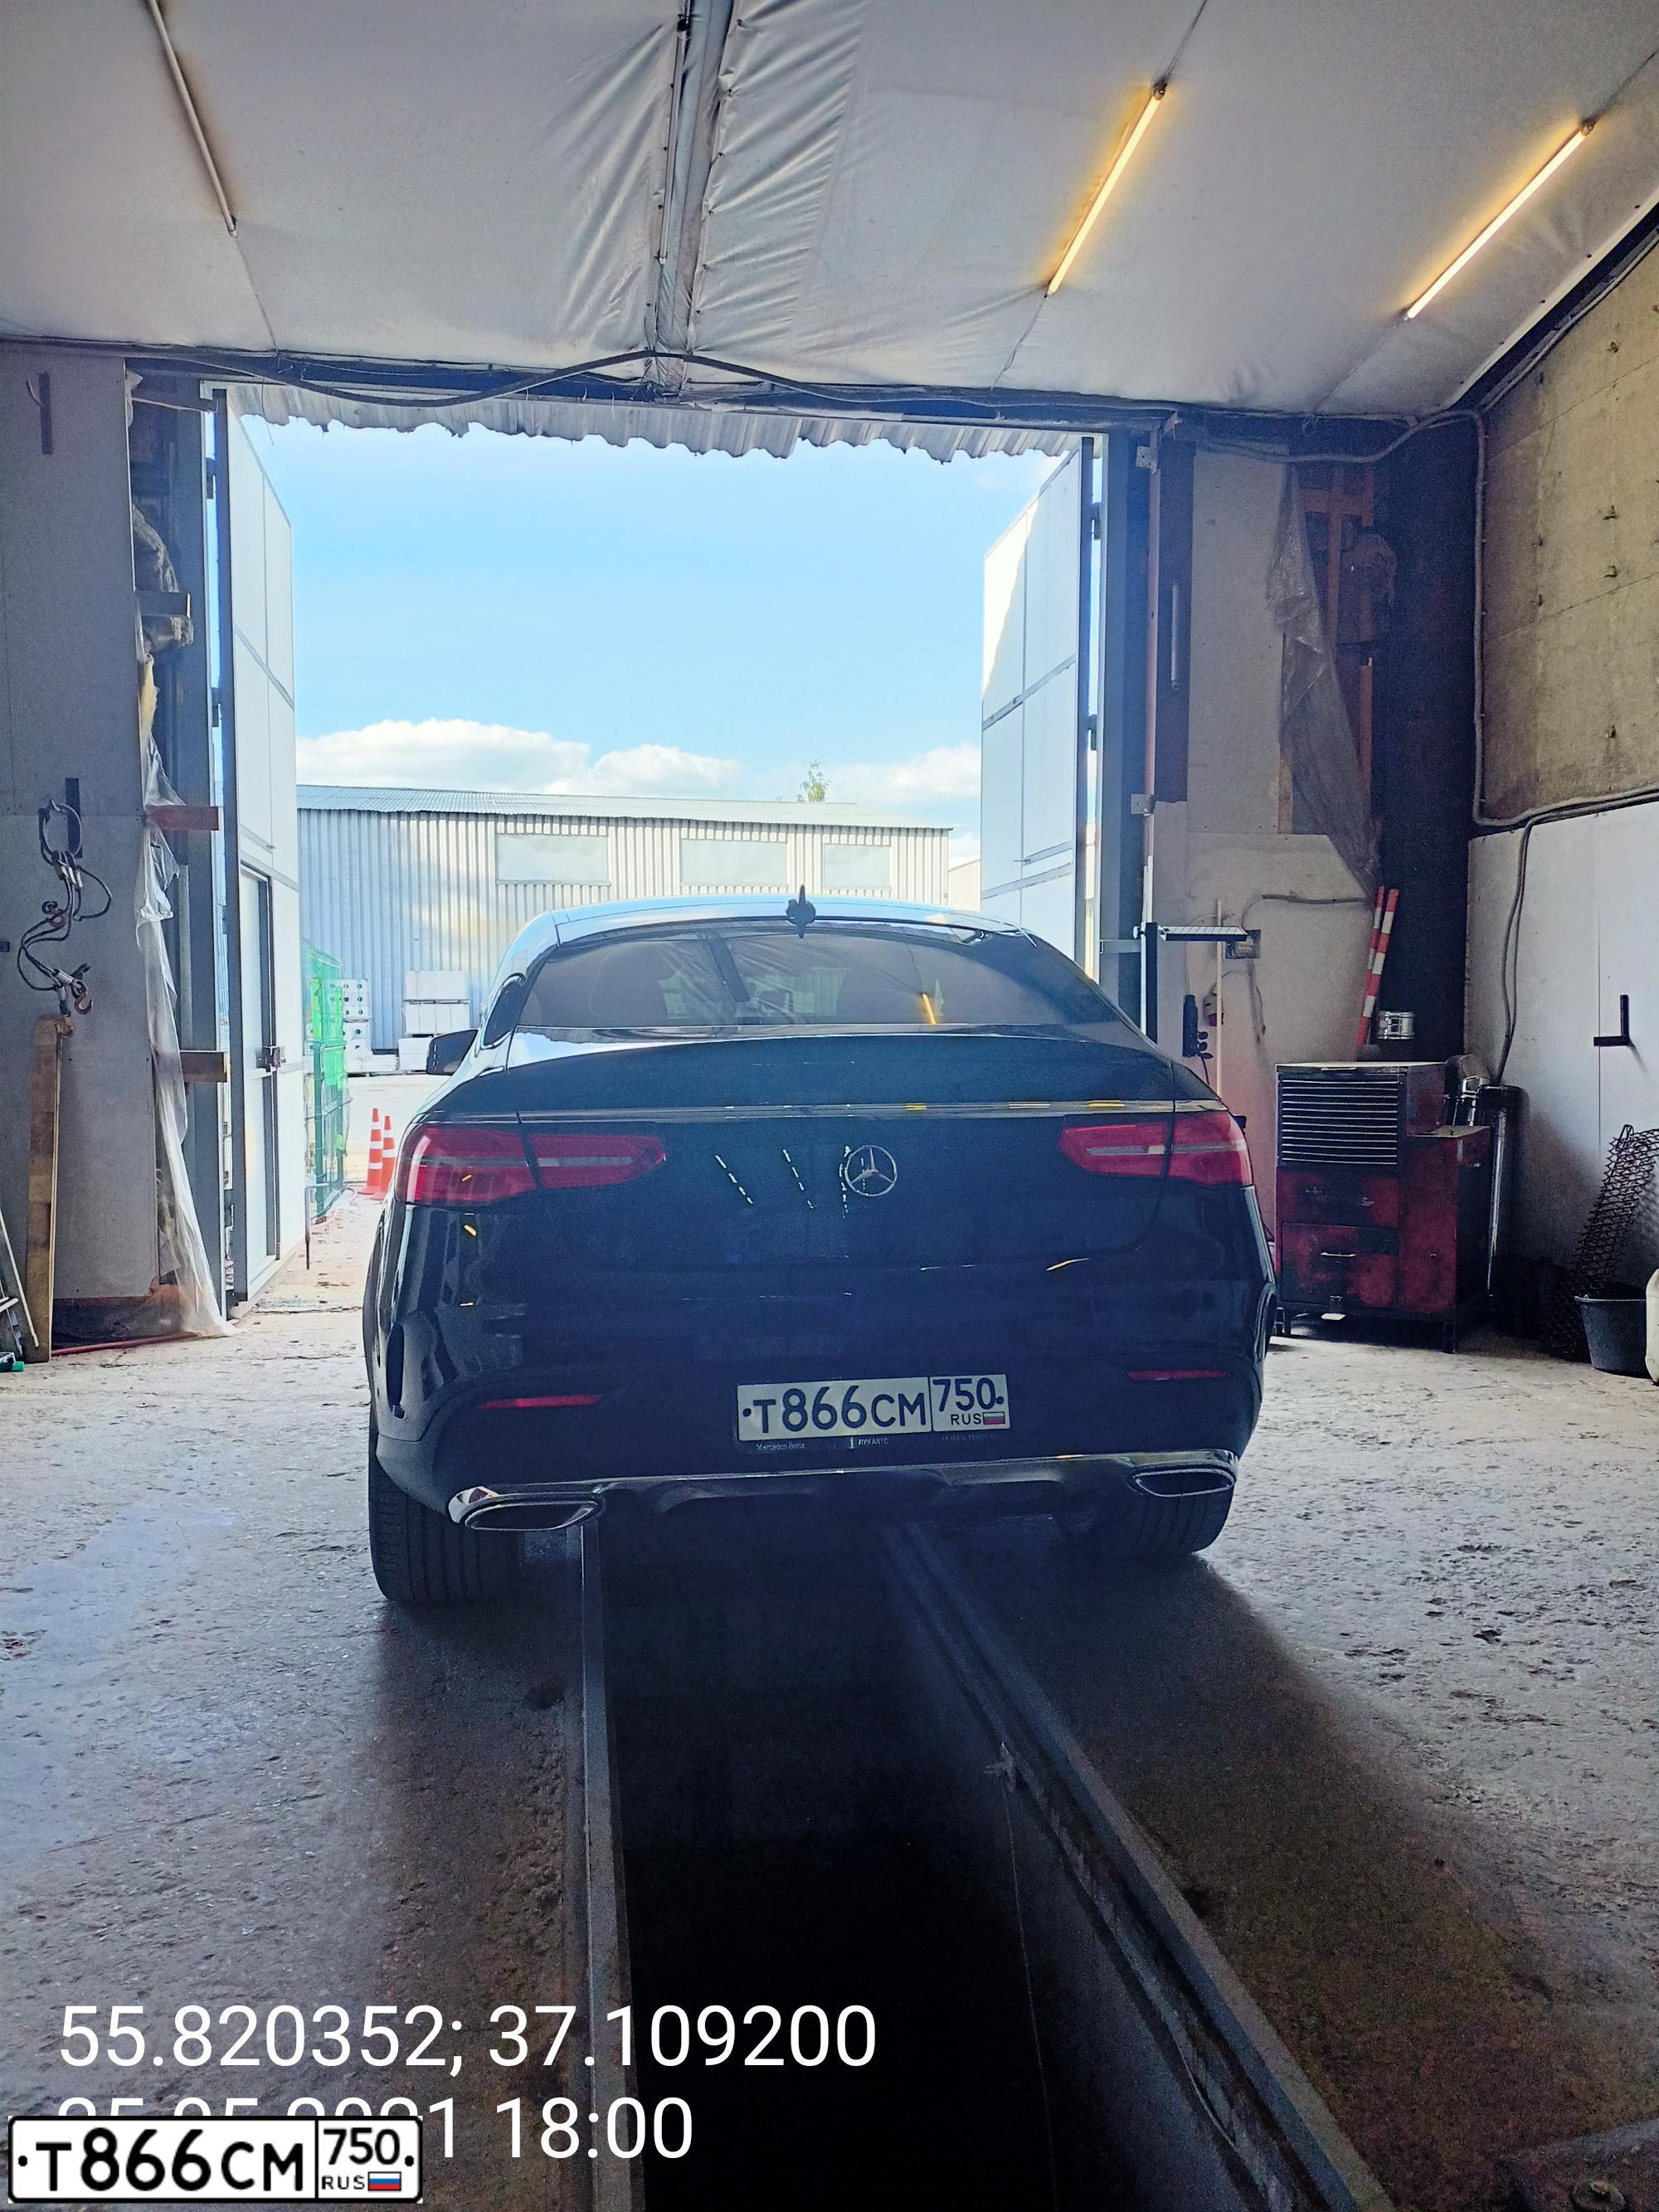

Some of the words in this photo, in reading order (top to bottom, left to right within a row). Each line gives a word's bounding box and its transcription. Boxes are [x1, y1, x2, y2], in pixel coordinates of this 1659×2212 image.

[753, 1385, 927, 1434] Т866СМ
[932, 1377, 996, 1412] 750
[951, 1413, 982, 1425] RUS
